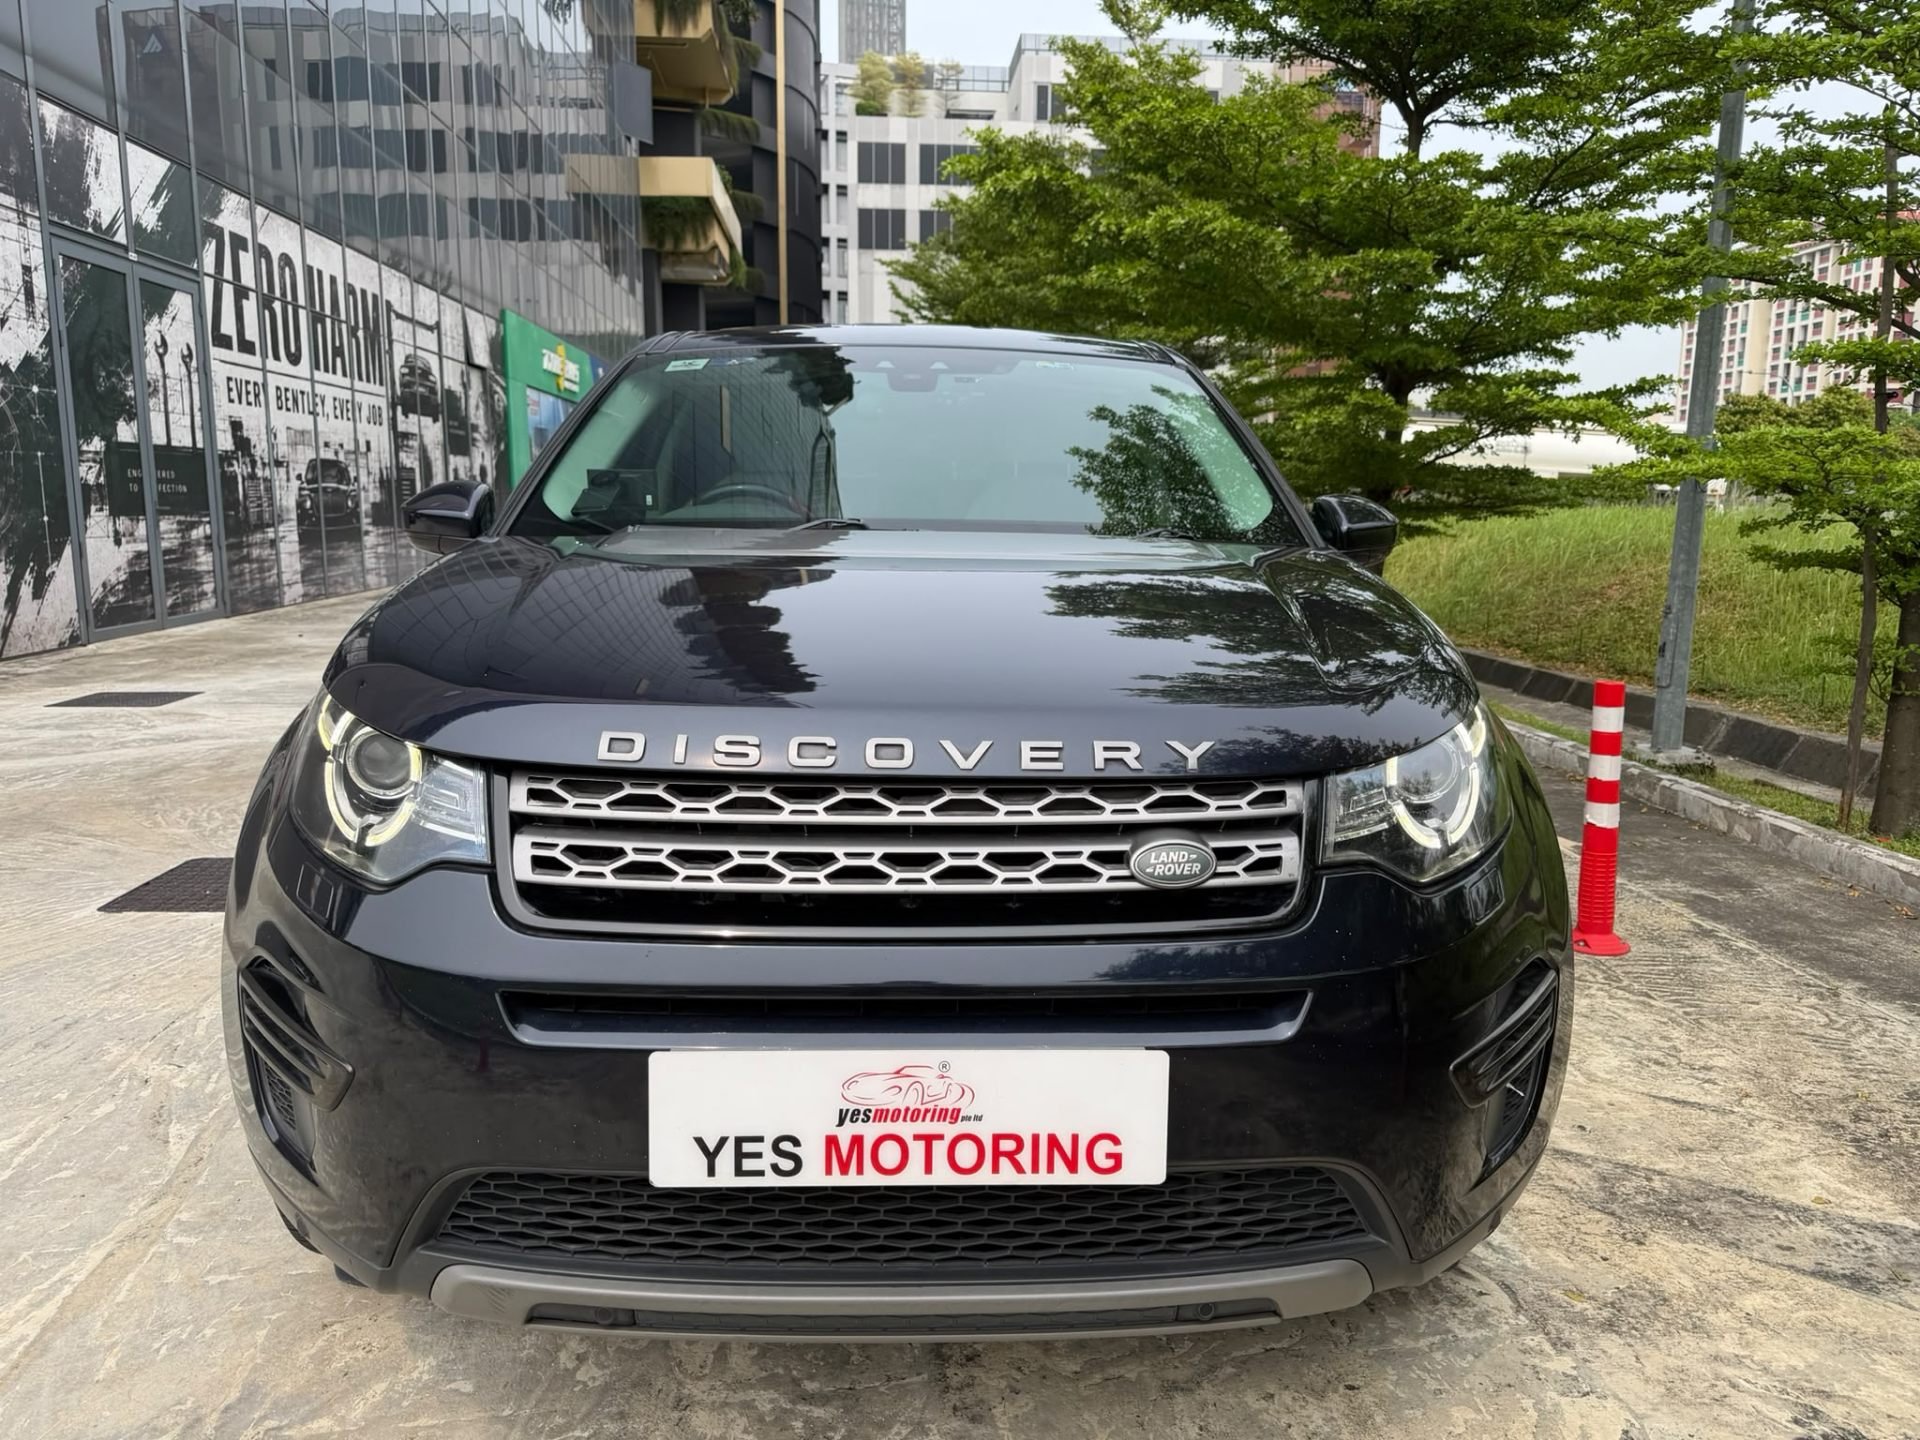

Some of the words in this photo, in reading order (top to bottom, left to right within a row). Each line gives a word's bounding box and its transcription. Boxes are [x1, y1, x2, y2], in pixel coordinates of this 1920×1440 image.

[201, 220, 303, 367] ZERO
[306, 263, 385, 387] HARM
[333, 396, 363, 423] EVEY
[366, 403, 383, 426] JOB
[129, 483, 139, 492] TO
[597, 731, 1215, 772] DISCOVERY
[1150, 851, 1189, 864] LAND
[1154, 862, 1202, 876] ROVER
[836, 1104, 962, 1128] yesmotoring
[960, 1114, 972, 1122] pte
[973, 1113, 984, 1122] ltd
[693, 1135, 803, 1178] YES
[824, 1132, 1124, 1176] MOTORING
